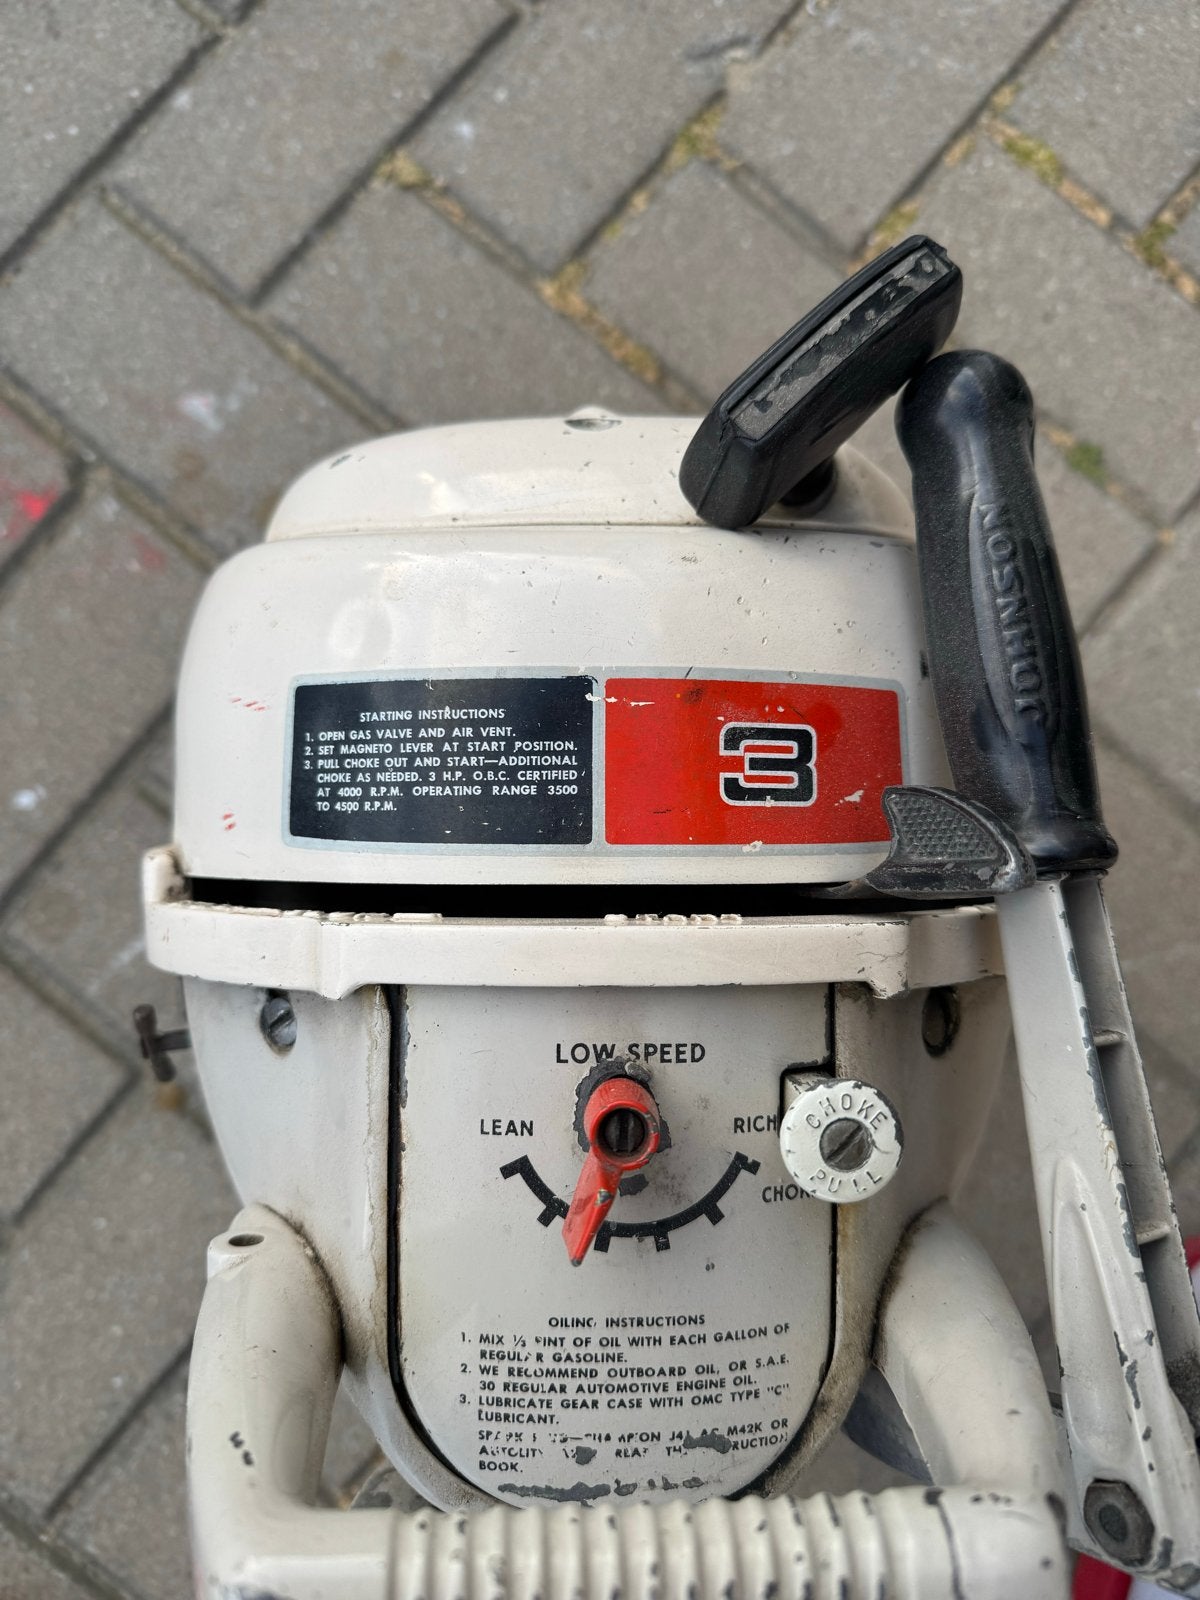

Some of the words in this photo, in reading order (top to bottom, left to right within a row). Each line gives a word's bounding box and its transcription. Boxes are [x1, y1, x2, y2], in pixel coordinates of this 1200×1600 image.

[360, 711, 413, 722] STARTING
[418, 708, 505, 720] INSTRUCTIONS
[305, 733, 314, 742] 1.
[319, 731, 345, 741] OPEN
[350, 730, 372, 740] GAS
[376, 729, 412, 739] VALVE
[419, 728, 445, 738] AND
[452, 727, 473, 737] AIR
[481, 727, 516, 737] VENT.
[304, 747, 313, 756] 2.
[318, 745, 334, 755] SET
[340, 743, 393, 754] MAGNETO
[401, 742, 434, 753] LEVER
[442, 742, 458, 752] AT
[467, 741, 506, 752] START
[514, 741, 578, 752] POSITION.
[304, 760, 313, 770] 3.
[318, 758, 339, 769] PULL
[344, 758, 379, 768] CHOKE
[386, 757, 407, 768] OUT
[414, 757, 440, 767] AND
[719, 721, 817, 807] 3
[317, 772, 351, 782] CHOKE
[357, 772, 371, 782] AS
[377, 771, 422, 782] NEEDED.
[429, 771, 435, 781] 3
[443, 771, 466, 781] H.P.
[473, 771, 510, 781] O.B.C.
[517, 770, 578, 781] CERTIFIED
[317, 787, 330, 797] AT
[338, 787, 362, 797] 4000
[370, 786, 403, 797] R.P.M.
[413, 785, 482, 796] OPERATING
[492, 785, 537, 795] RANGE
[548, 785, 578, 795] 3500
[317, 801, 330, 811] TO
[335, 801, 359, 813] 4500
[365, 802, 397, 811] R.P.M.
[556, 1043, 616, 1064] LOW
[628, 1043, 706, 1063] SPEED
[805, 1093, 888, 1131] CHOKE
[480, 1119, 534, 1136] LEAN
[734, 1115, 777, 1133] RICH
[811, 1168, 882, 1193] PULL
[762, 1186, 816, 1204] CHOK
[606, 1314, 705, 1328] INSTRUCTIONS
[461, 1332, 471, 1343] 1.
[479, 1334, 504, 1346] MIX
[573, 1336, 591, 1348] OF
[599, 1336, 621, 1348] OIL
[628, 1335, 662, 1347] WITH
[670, 1333, 707, 1346] EACH
[714, 1326, 767, 1343] GALLON
[774, 1323, 790, 1335] OF
[553, 1351, 628, 1363] GASOLINE.
[460, 1364, 471, 1374] 2.
[480, 1364, 499, 1376] WE
[508, 1366, 598, 1378] RECOMMEND
[608, 1365, 686, 1378] OUTBOARD
[695, 1363, 720, 1376] OIL,
[729, 1359, 747, 1372] OR
[755, 1354, 789, 1369] S.A.E.
[480, 1380, 495, 1391] 30
[504, 1381, 567, 1393] REGULAR
[576, 1380, 669, 1394] AUTOMOTIVE
[677, 1377, 726, 1391] ENGINE
[733, 1375, 757, 1387] OIL.
[460, 1394, 471, 1404] 3.
[479, 1396, 553, 1409] LUBRICATE
[561, 1398, 599, 1410] GEAR
[607, 1396, 643, 1409] CASE
[650, 1395, 683, 1407] WITH
[691, 1393, 722, 1405] OMC
[731, 1388, 760, 1403] TYPE
[478, 1409, 559, 1425] LUBRICANT.
[727, 1422, 762, 1437] M42K
[771, 1418, 788, 1430] OR
[479, 1460, 523, 1472] BOOK.
